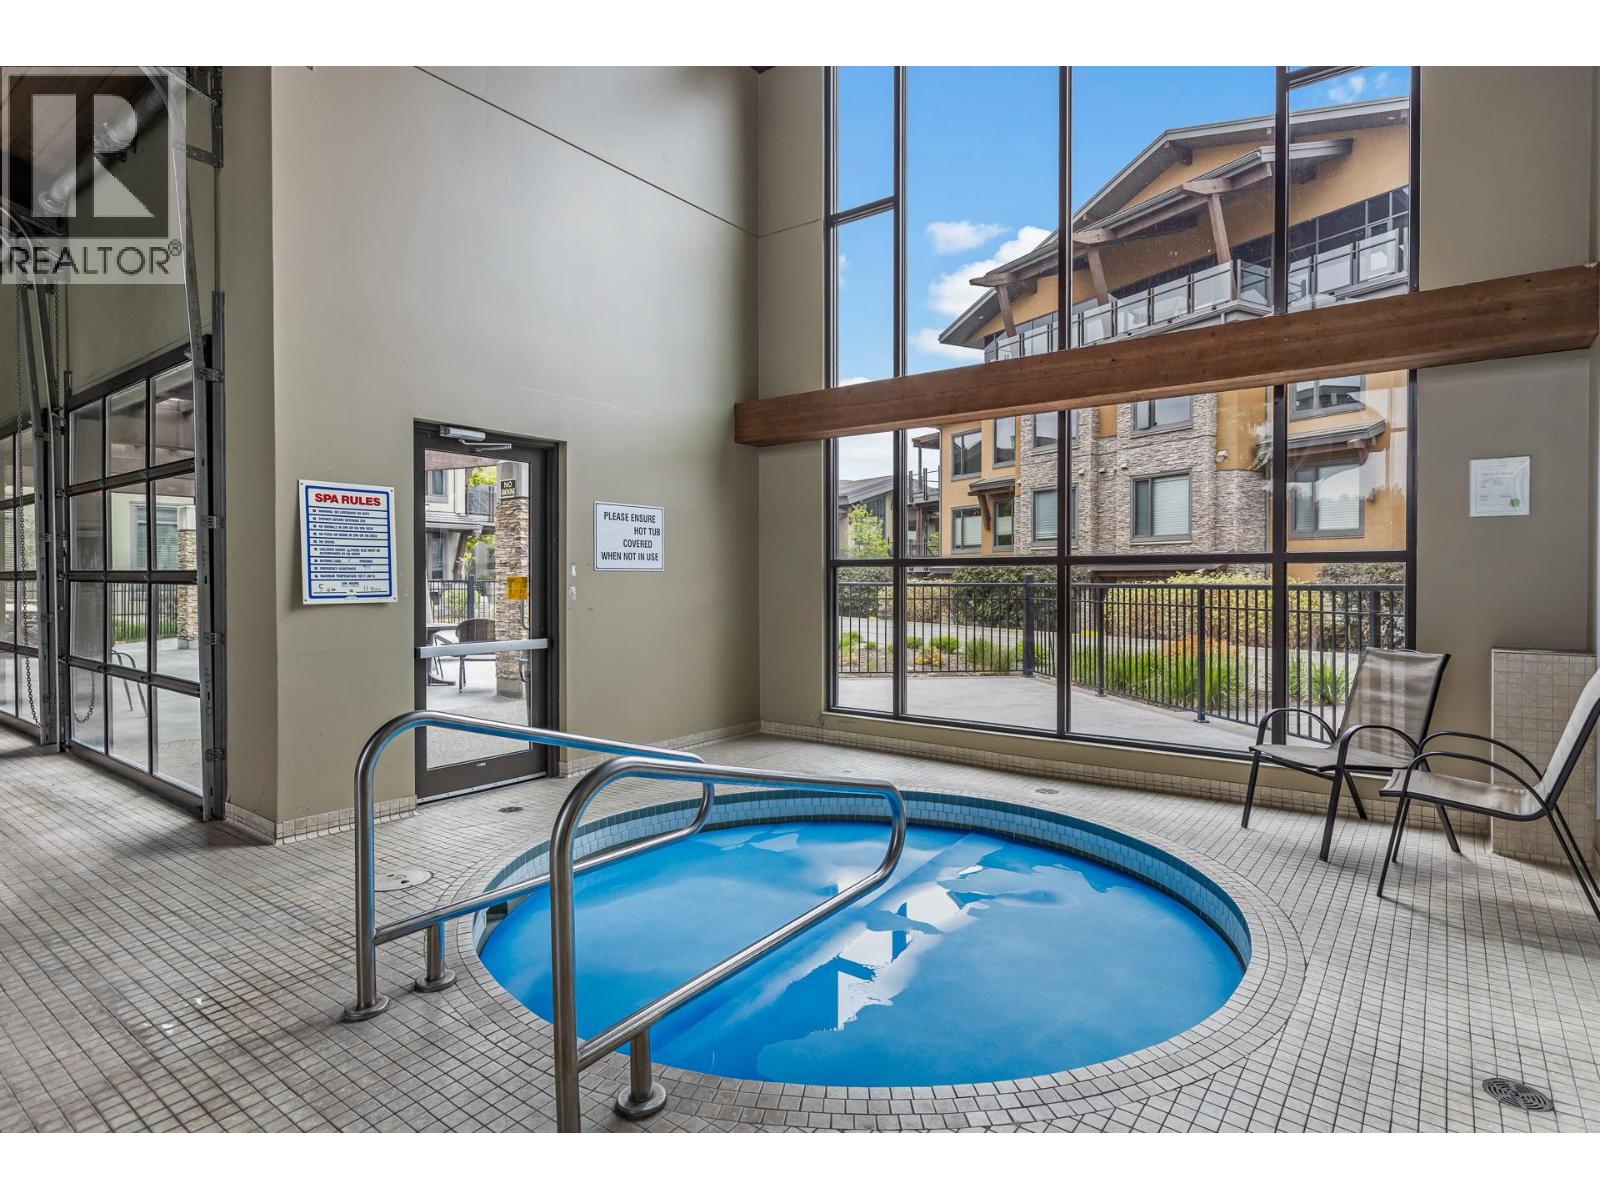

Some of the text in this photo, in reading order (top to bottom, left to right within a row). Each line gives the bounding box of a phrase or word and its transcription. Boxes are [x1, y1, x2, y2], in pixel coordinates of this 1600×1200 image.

[315, 493, 381, 506] SPA RULES
[604, 512, 656, 523] PLEASE ENSURE
[634, 527, 660, 536] HOT TUB
[623, 539, 653, 548] COVERED
[601, 552, 621, 560] WHEN
